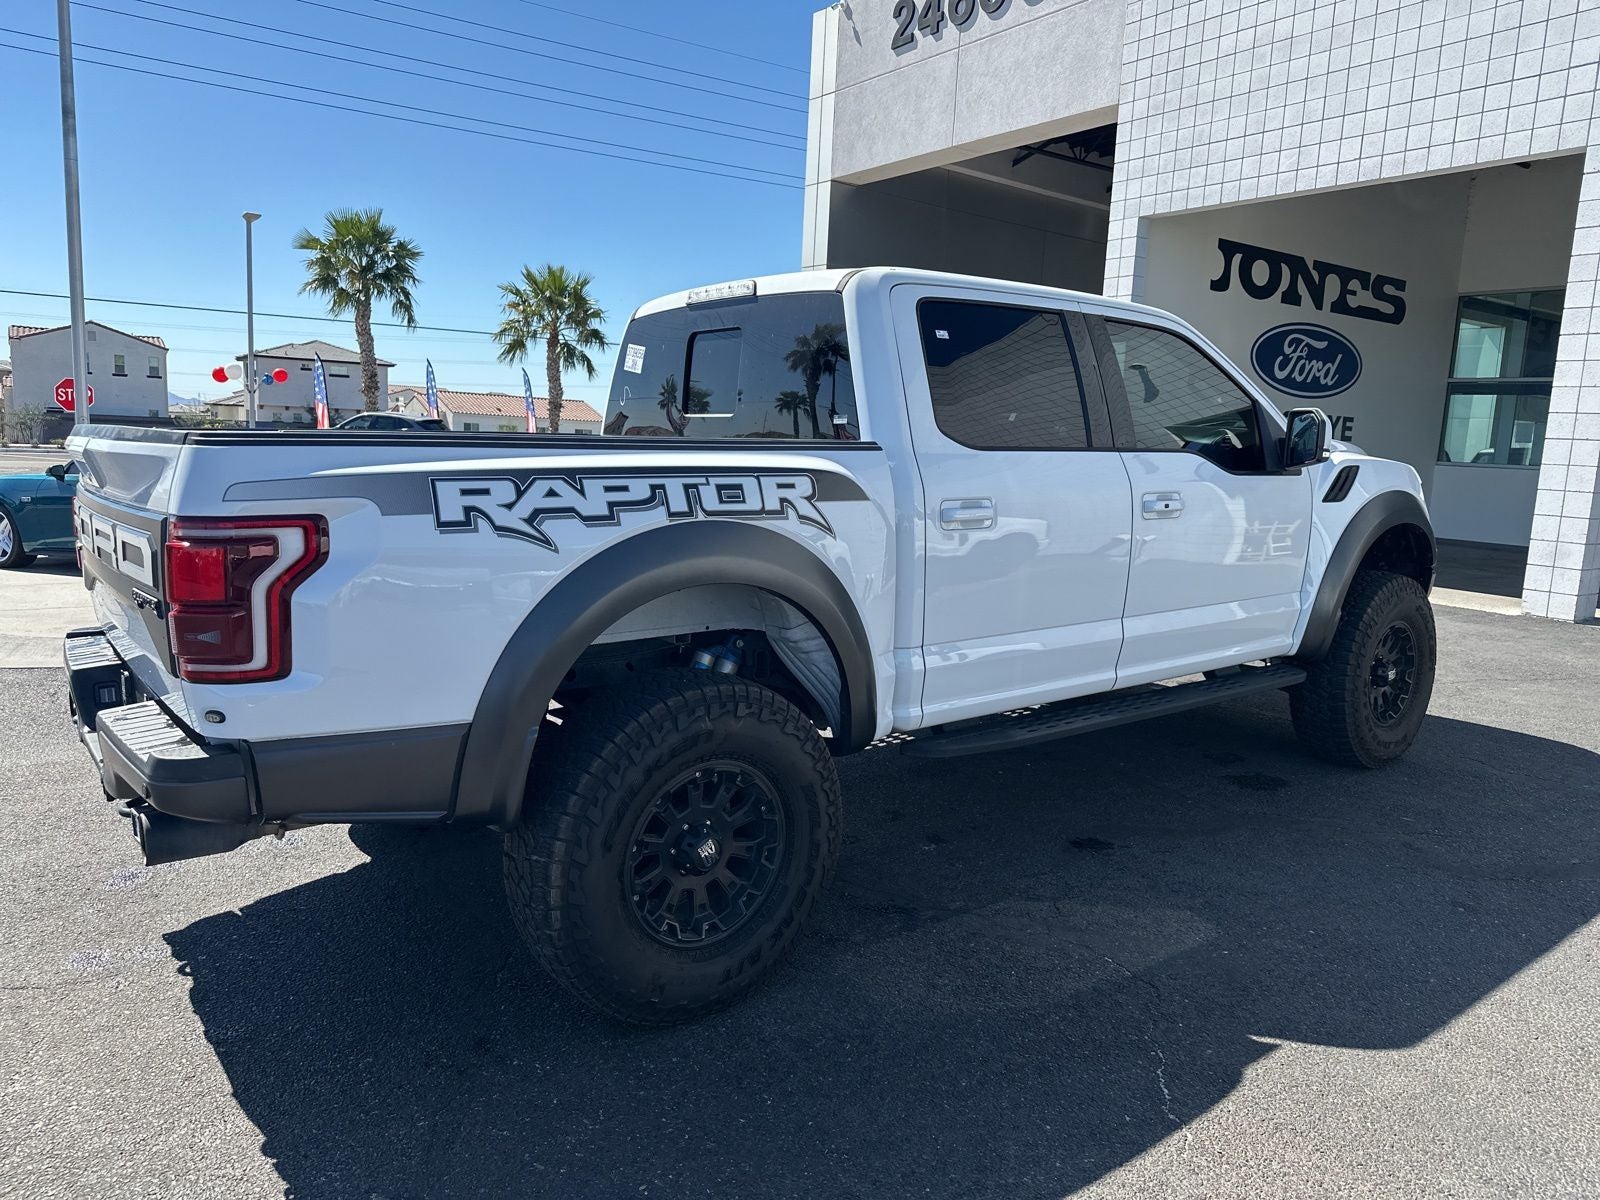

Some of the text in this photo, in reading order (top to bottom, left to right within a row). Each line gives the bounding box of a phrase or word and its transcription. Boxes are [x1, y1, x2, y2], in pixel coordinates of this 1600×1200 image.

[1210, 238, 1407, 325] JONES
[58, 387, 91, 401] ST
[1274, 333, 1343, 386] Ford
[75, 504, 157, 590] ORD
[428, 472, 837, 551] RAPTOR
